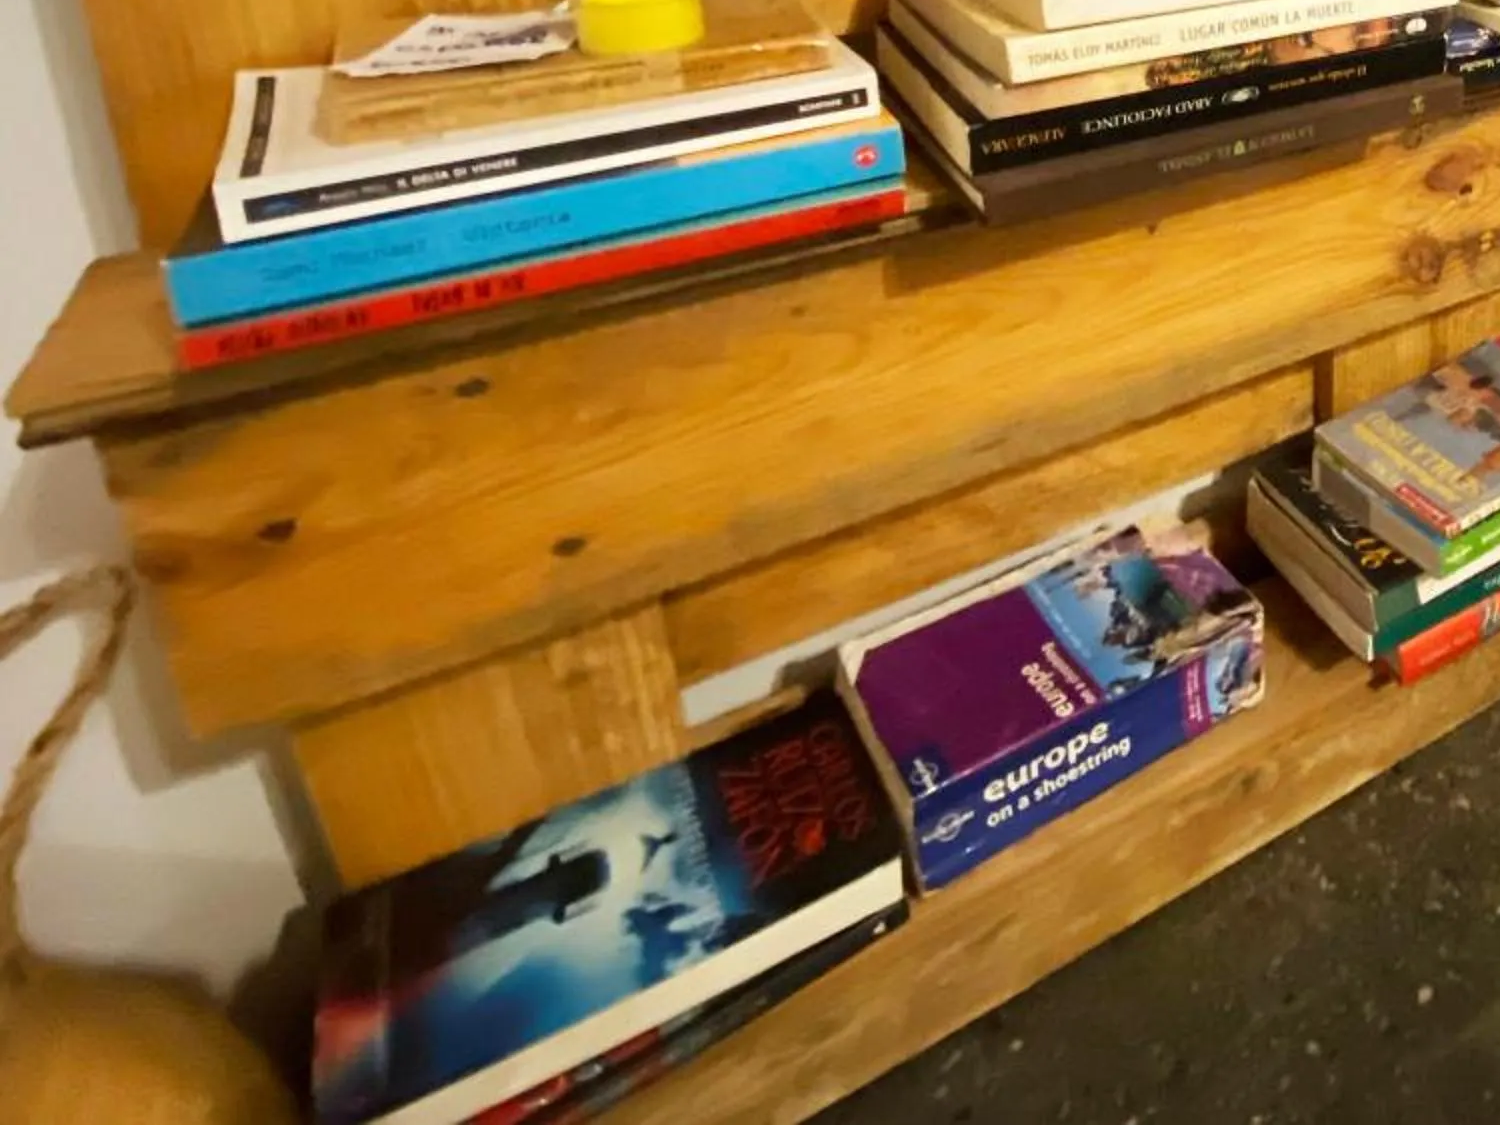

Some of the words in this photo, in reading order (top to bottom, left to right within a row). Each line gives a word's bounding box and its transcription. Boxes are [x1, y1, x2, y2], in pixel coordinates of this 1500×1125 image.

[1179, 19, 1227, 43] LUGAR
[1283, 6, 1303, 27] LA
[1081, 105, 1174, 136] FACIOLINCE
[1174, 96, 1214, 118] ABAD
[1020, 661, 1076, 718] europe
[982, 720, 1111, 805] europe
[985, 807, 1013, 828] on
[1017, 797, 1030, 812] a
[1033, 736, 1133, 801] shoestring
